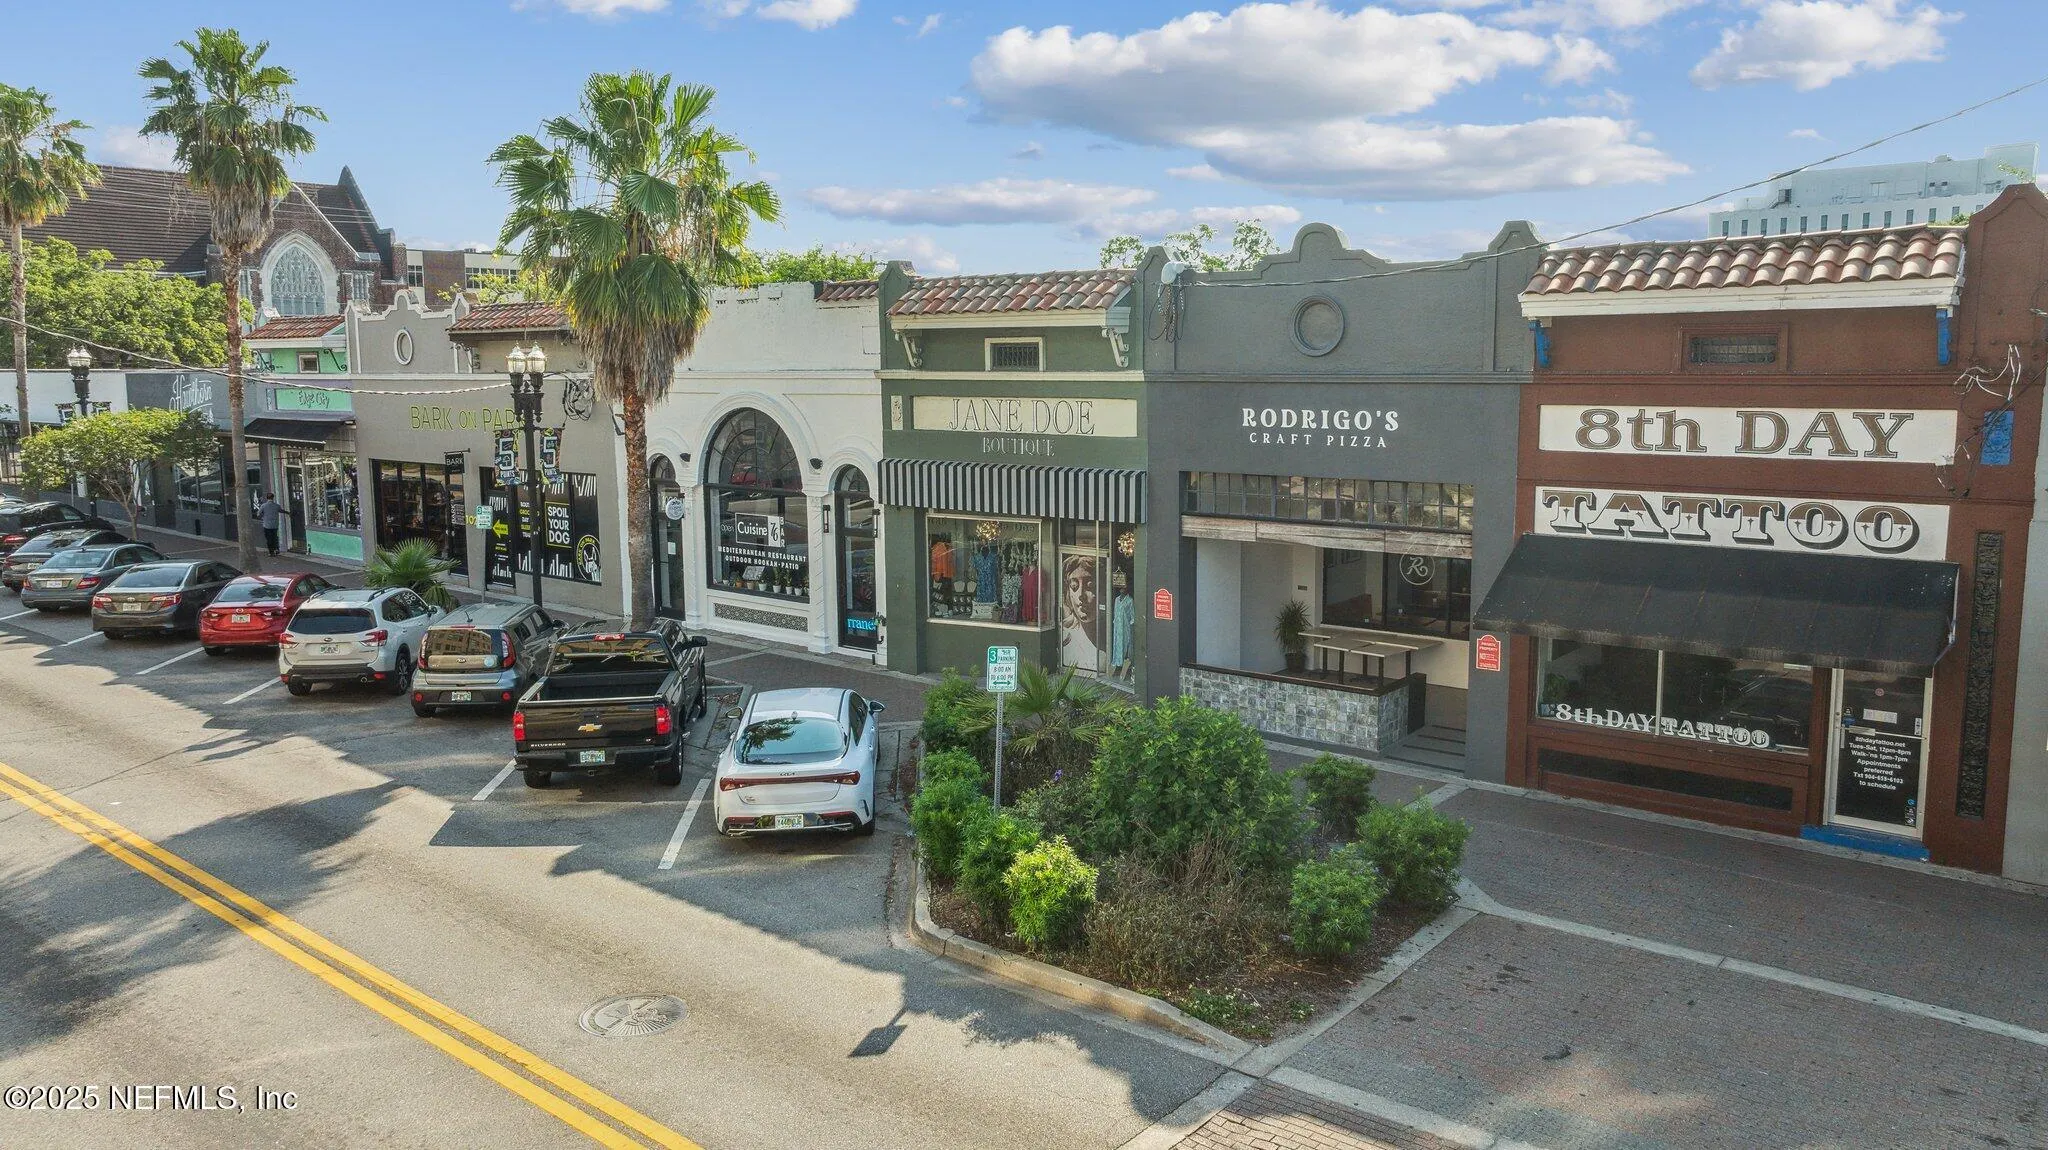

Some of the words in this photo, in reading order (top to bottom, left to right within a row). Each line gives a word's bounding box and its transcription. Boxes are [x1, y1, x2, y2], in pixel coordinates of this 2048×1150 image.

[411, 406, 453, 430] BARK
[459, 410, 477, 429] ON
[949, 399, 1023, 432] JANE
[1032, 400, 1095, 434] DOE
[1242, 408, 1399, 431] RODRIGO'S
[1250, 432, 1312, 445] CRAFT
[1327, 435, 1386, 447] PIZZA
[1576, 408, 1707, 452] 8th
[1735, 410, 1914, 458] DAY
[983, 437, 1055, 456] BOUTIQUE
[547, 506, 569, 518] SPOIL
[548, 519, 569, 531] YOUR
[1543, 489, 1919, 554] TATTOO
[548, 530, 570, 544] DOG
[737, 521, 768, 536] Cuisine
[770, 522, 779, 541] 76
[718, 546, 766, 557] MEDITERRANEAN
[767, 551, 806, 562] RESTAURANT
[725, 555, 752, 564] OUTDOOR
[990, 650, 997, 662] 3
[1661, 716, 1770, 748] TATTOO
[1857, 758, 1901, 769] Appointments
[1864, 767, 1893, 776] preferred
[1867, 782, 1896, 790] schedule
